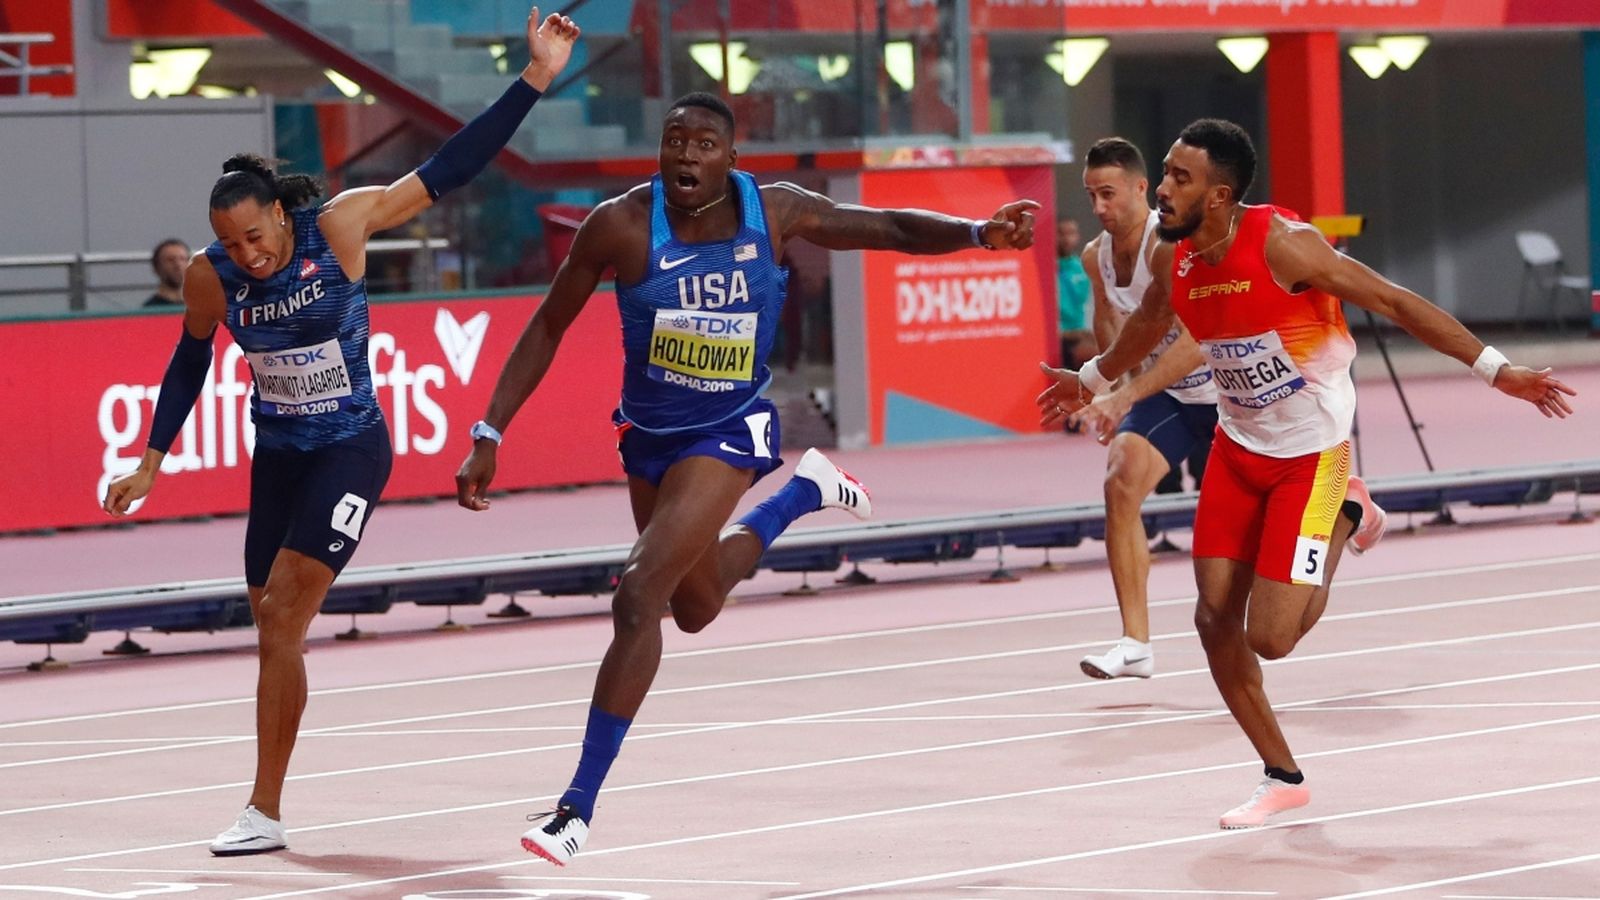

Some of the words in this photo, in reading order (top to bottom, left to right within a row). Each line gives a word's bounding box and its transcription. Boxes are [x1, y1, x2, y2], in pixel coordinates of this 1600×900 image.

[251, 279, 326, 325] FRANCE
[678, 270, 749, 310] USA
[1188, 279, 1251, 300] ESPAÑA
[690, 315, 744, 335] TDK
[275, 347, 327, 366] TDK
[653, 335, 750, 372] HOLLOWAY
[1220, 339, 1268, 359] TDK
[1214, 355, 1292, 392] ORTEGA
[276, 399, 340, 415] DOHA2019
[345, 501, 359, 526] 7
[1304, 549, 1319, 575] 5
